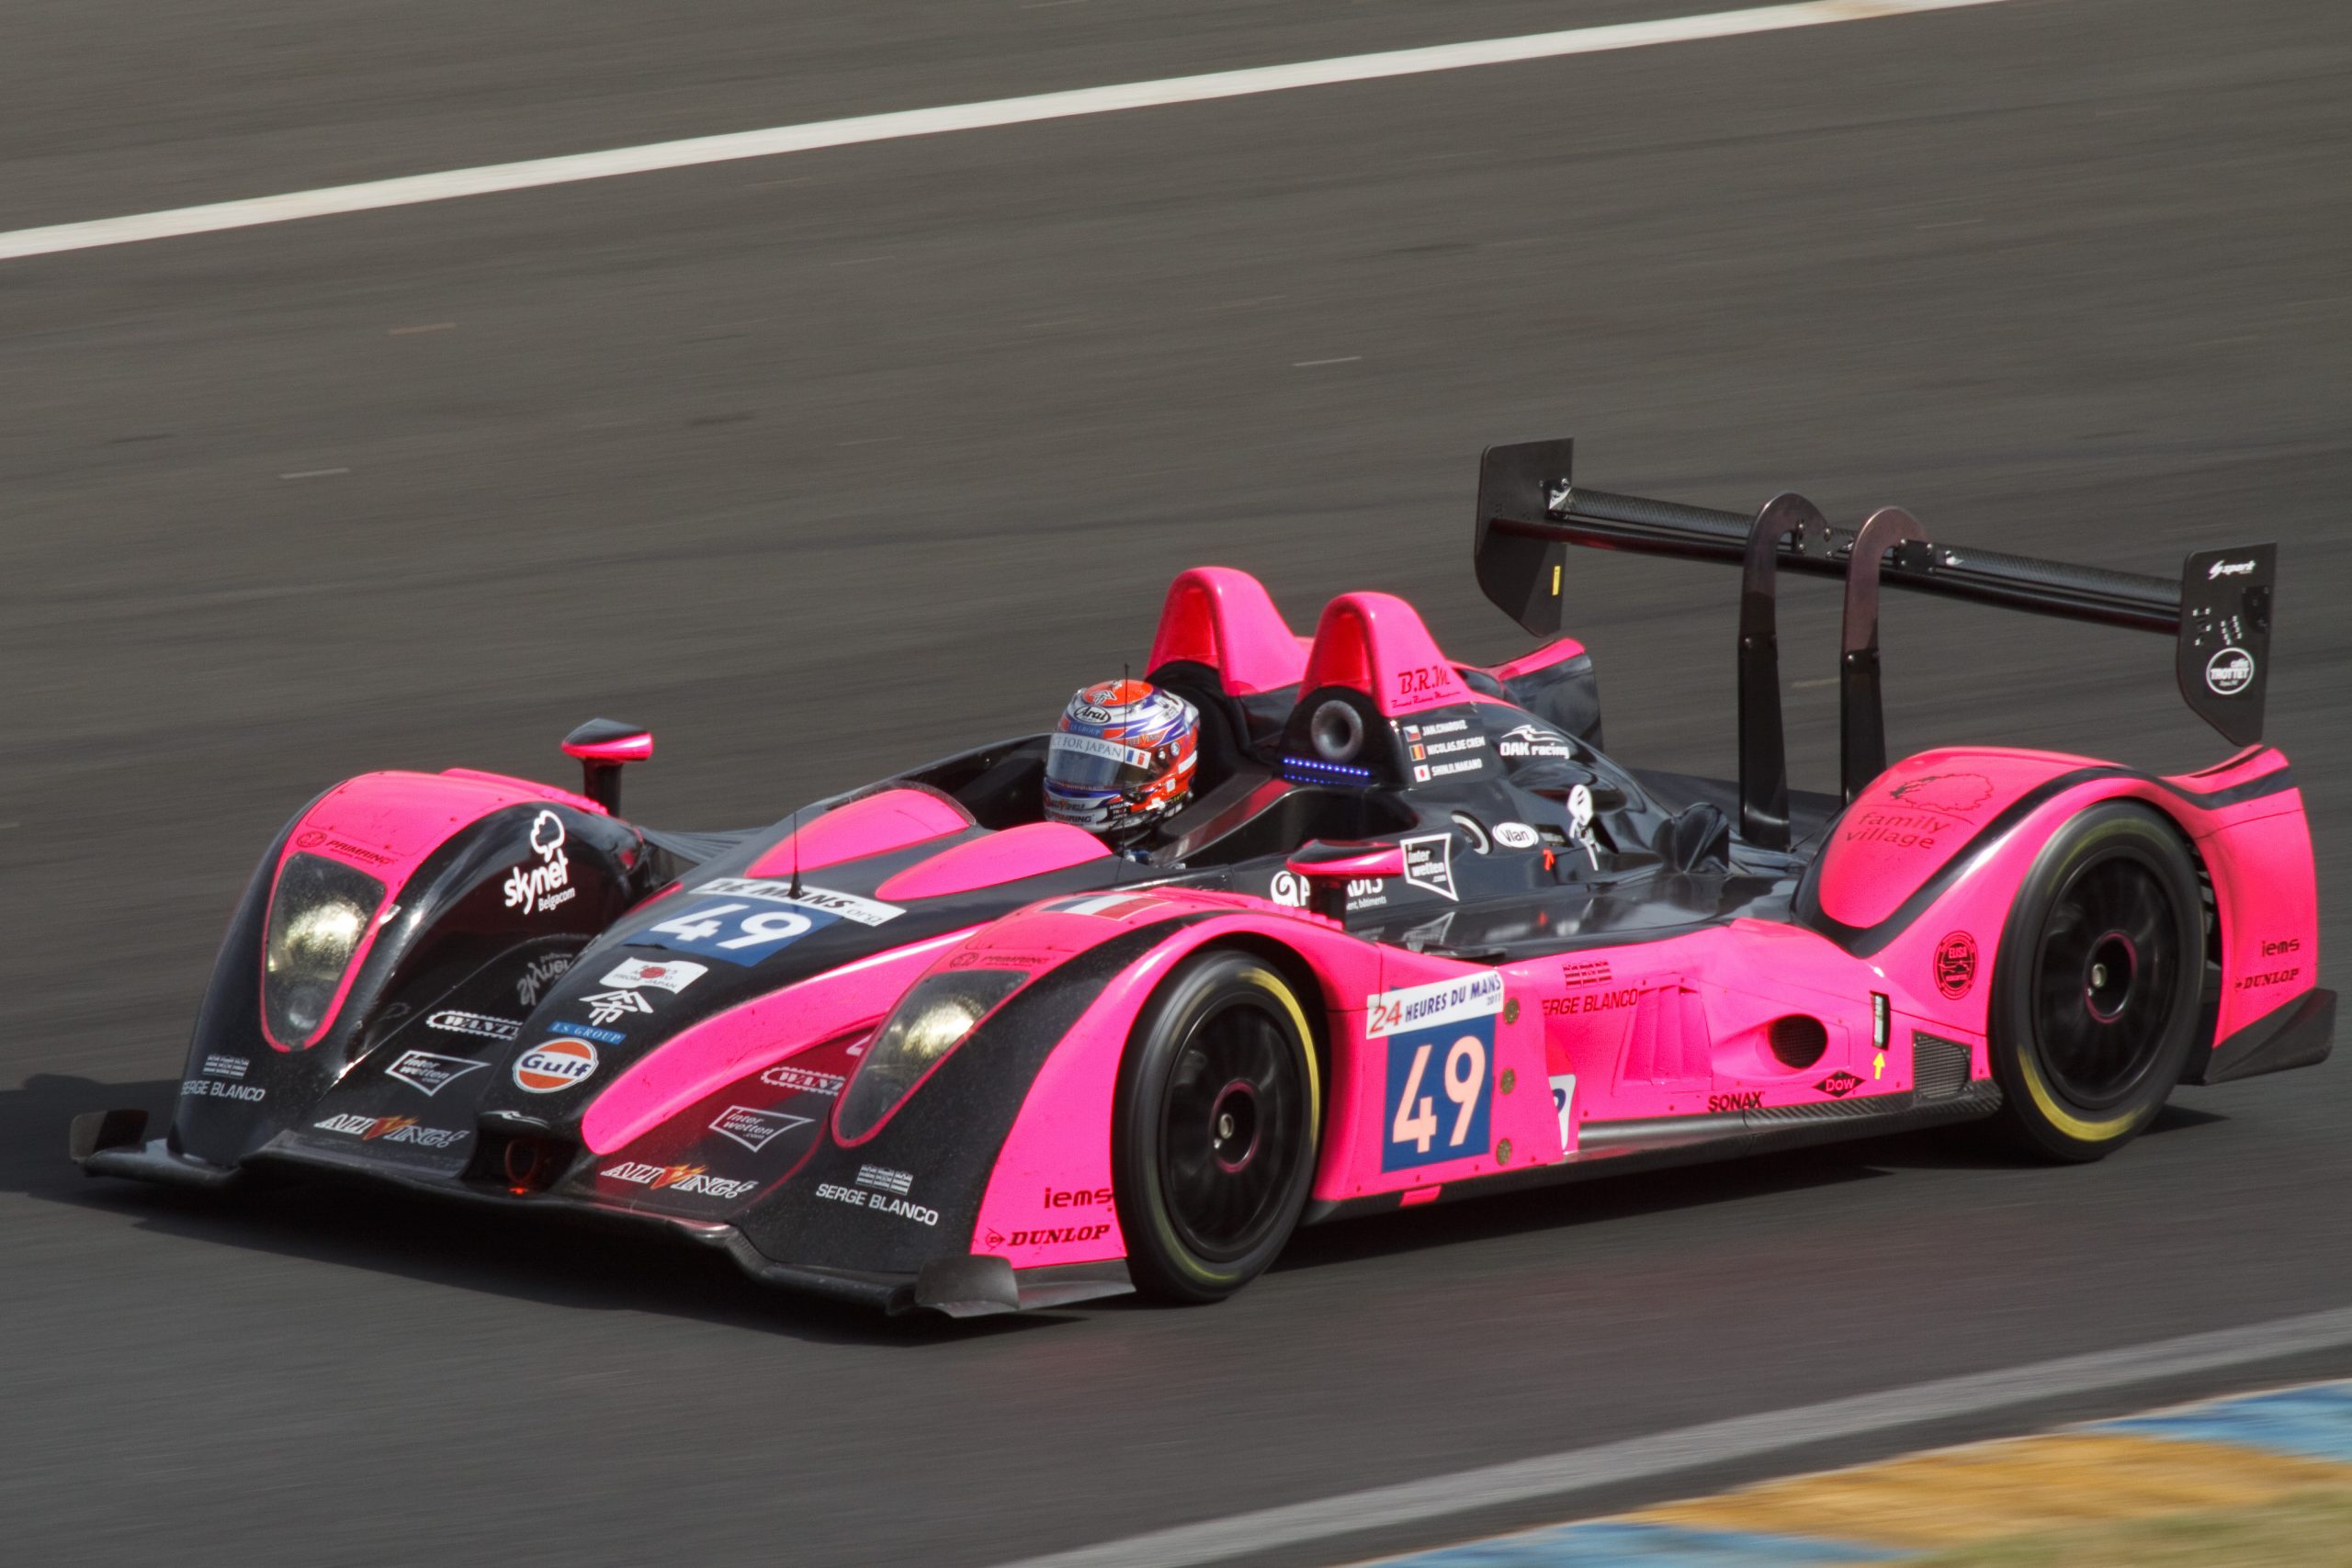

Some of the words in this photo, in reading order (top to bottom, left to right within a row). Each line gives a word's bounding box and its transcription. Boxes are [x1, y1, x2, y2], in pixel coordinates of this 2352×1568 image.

[1080, 705, 1107, 721] Arai
[1062, 736, 1084, 750] FOR
[1086, 739, 1125, 758] JAPAN
[1499, 742, 1530, 756] OAK
[1531, 742, 1570, 760] racing
[1859, 811, 1951, 832] family
[1502, 829, 1532, 843] Vlan
[1846, 828, 1935, 850] village
[1408, 844, 1431, 863] inter
[1411, 862, 1445, 877] wetten
[503, 847, 569, 916] skynet
[538, 886, 576, 912] Belgacom
[650, 903, 813, 950] 49
[2261, 939, 2301, 957] iems
[2243, 968, 2300, 989] DUNLOP
[1368, 999, 1403, 1034] 24
[1405, 992, 1448, 1022] HEURES
[1451, 986, 1467, 1007] DU
[1470, 974, 1501, 1000] MANS
[1542, 997, 1580, 1016] ERGE
[1582, 987, 1639, 1013] BLANCO
[573, 1027, 622, 1043] GROUP
[403, 1055, 441, 1069] inter
[521, 1053, 593, 1078] Gulf
[399, 1066, 450, 1080] wetten
[210, 1082, 266, 1102] BLANCO
[1392, 1035, 1486, 1153] 49
[1707, 1091, 1764, 1112] SONAX
[726, 1108, 765, 1125] inter
[722, 1121, 775, 1136] wetten
[815, 1183, 868, 1206] SERGE
[868, 1193, 939, 1226] BLANCO
[1044, 1186, 1114, 1209] iems
[1007, 1224, 1111, 1247] DUNLOP
